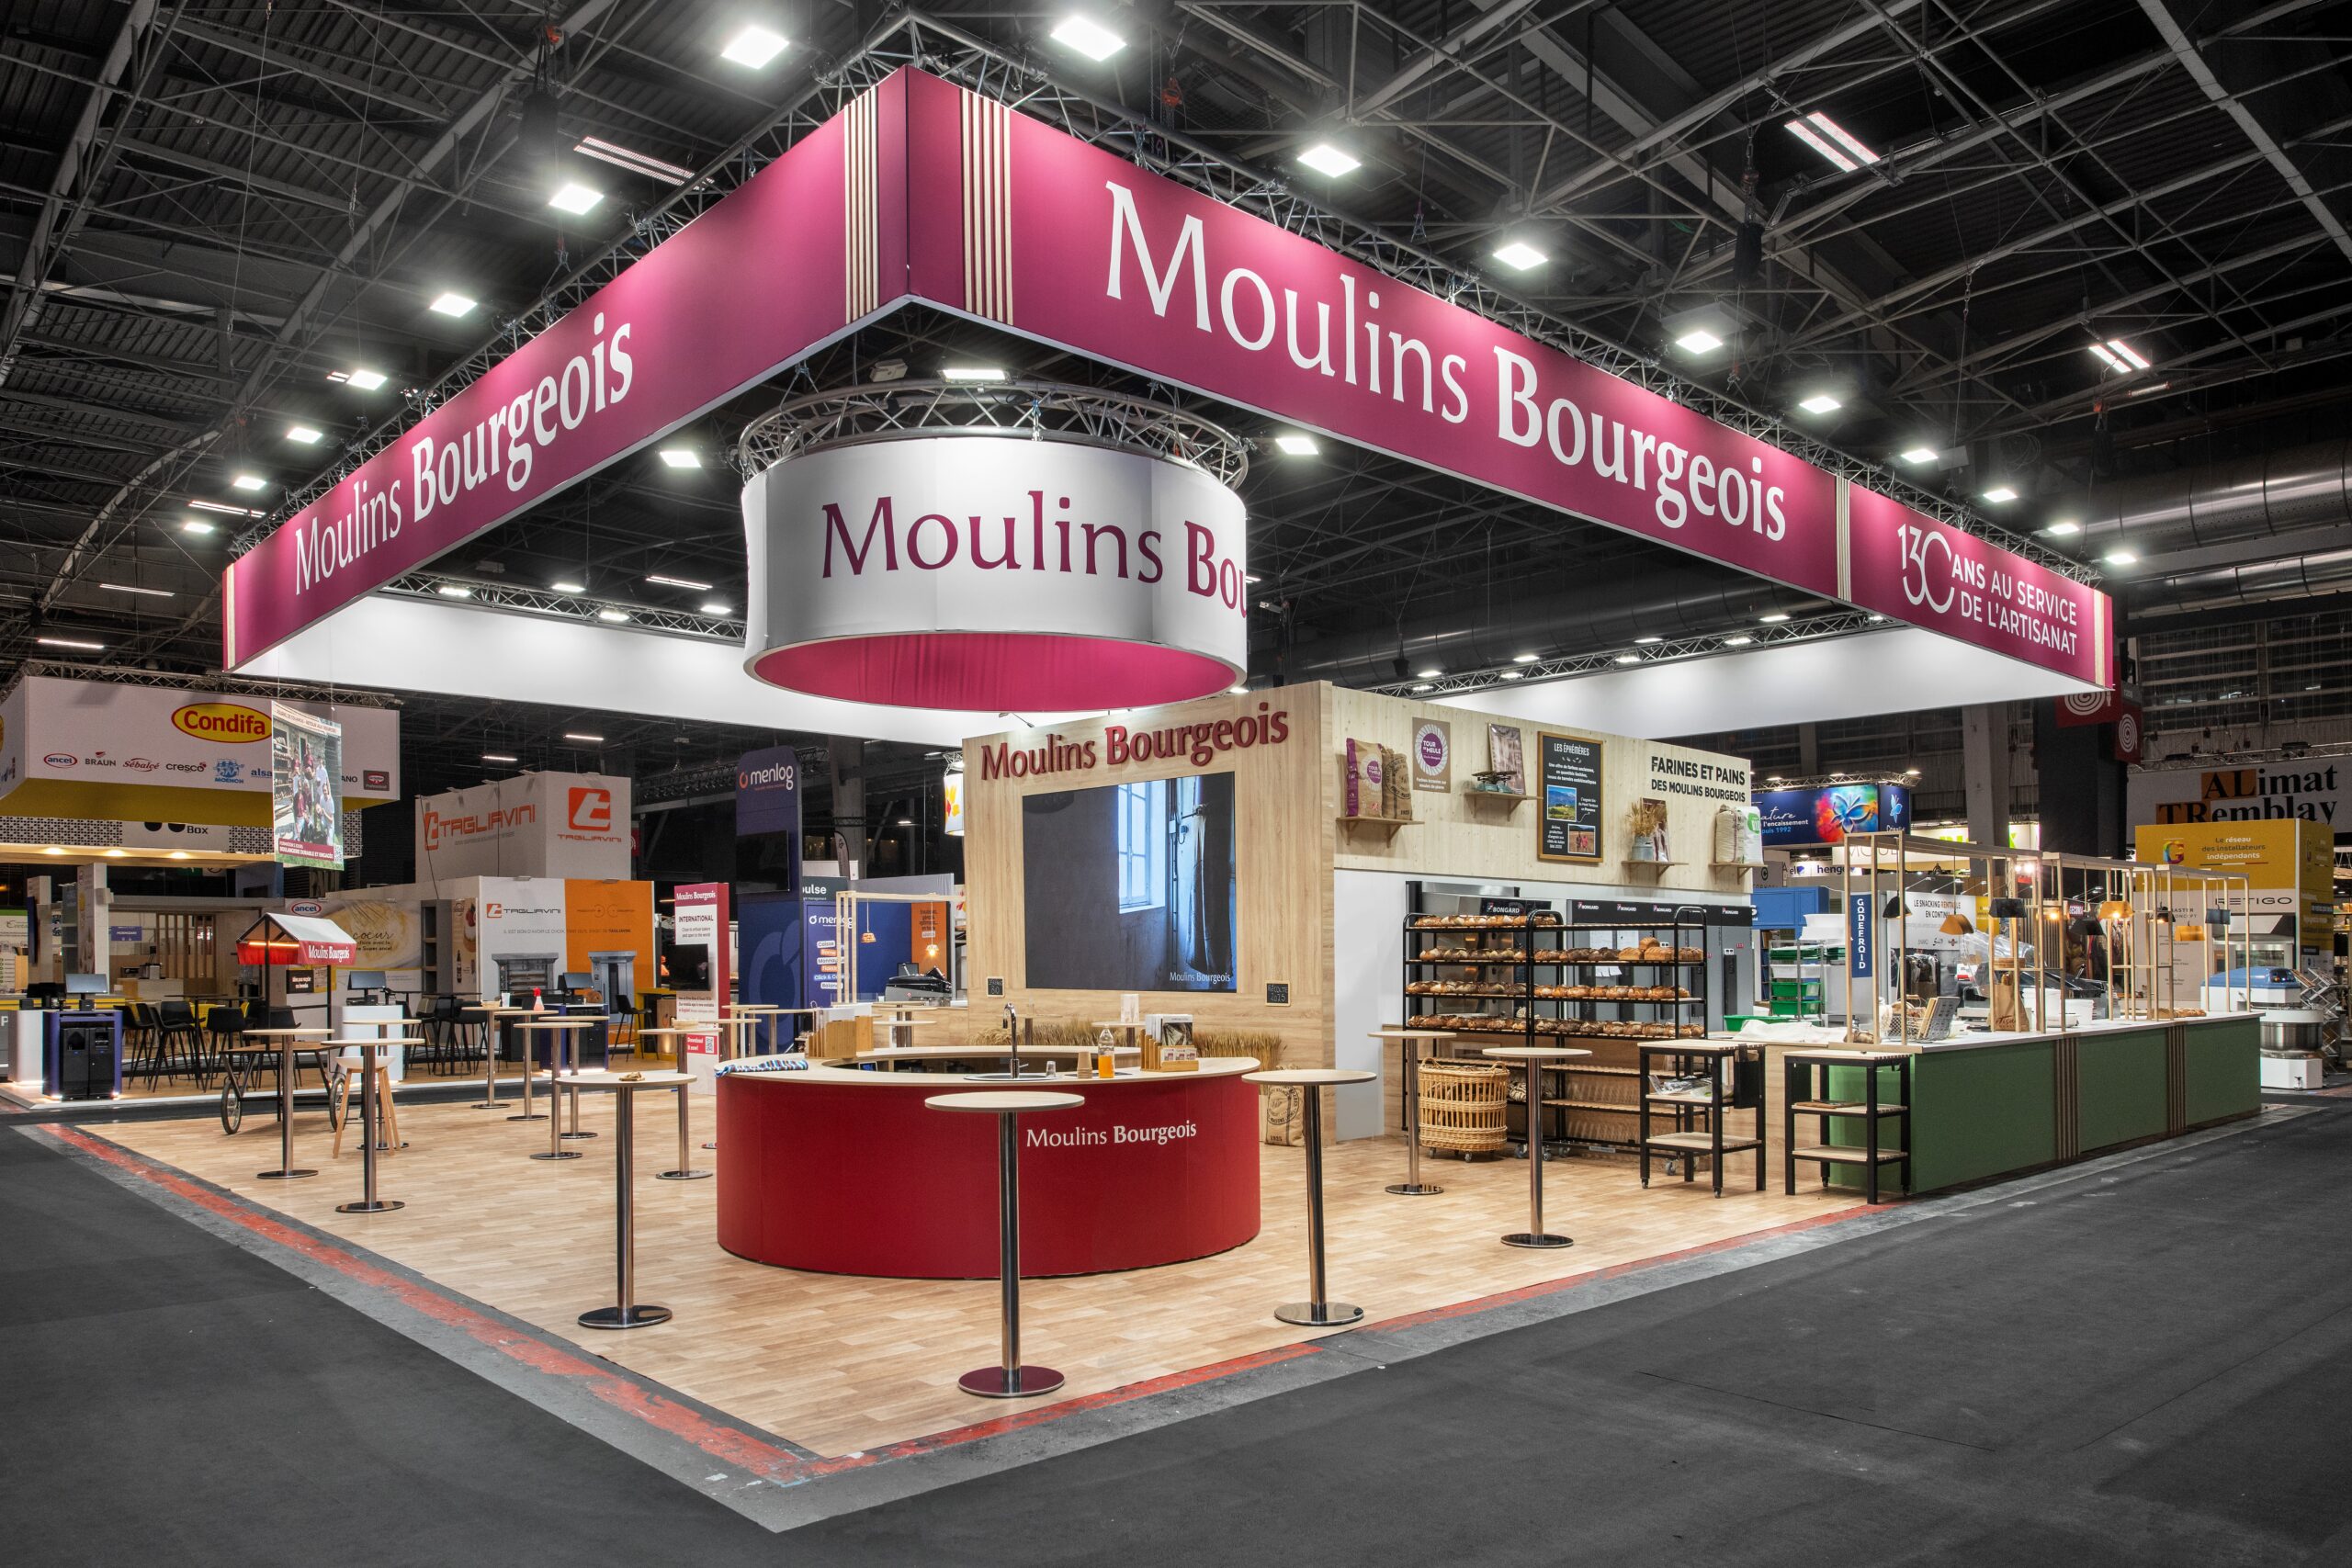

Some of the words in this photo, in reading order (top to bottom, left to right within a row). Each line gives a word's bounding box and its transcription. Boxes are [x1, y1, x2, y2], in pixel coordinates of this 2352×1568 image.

[1105, 180, 1468, 423] Moulins
[1493, 344, 1786, 541] Bourgeois
[295, 479, 401, 595] Moulins
[411, 311, 633, 523] Bourgeois
[822, 491, 1164, 583] Moulins
[1897, 523, 1955, 614] 130
[1951, 553, 1985, 590] ANS
[1990, 570, 2012, 600] AU
[2017, 580, 2077, 626] SERVICE
[1961, 591, 1983, 623] DE
[1987, 601, 2077, 656] L'ARTISANAT
[184, 710, 266, 735] Condifa
[980, 734, 1096, 781] Moulins
[1104, 702, 1289, 767] Bourgeois
[1554, 743, 1562, 752] LES
[85, 758, 117, 767] BRAUN
[165, 763, 205, 773] cresco
[251, 768, 273, 777] alsa
[1651, 755, 1698, 778] FARINES
[1701, 763, 1713, 780] ET
[1716, 767, 1746, 786] PAINS
[750, 762, 794, 790] menlog
[2204, 765, 2338, 799] ALimat
[1651, 779, 1668, 792] DES
[1669, 782, 1703, 797] MOULINS
[1705, 786, 1746, 803] BOURGEOIS
[187, 825, 209, 835] Box
[439, 804, 536, 837] TAGLIAVINI
[677, 892, 693, 900] Moulins
[693, 890, 716, 901] Bourgeois
[1919, 900, 1940, 908] SNACKING
[1941, 901, 1961, 909] RENTALE
[308, 944, 328, 959] Moulins
[328, 946, 350, 962] Bourgeois
[1169, 972, 1195, 982] Moulins
[1196, 972, 1231, 984] Bourgeois
[1026, 1127, 1108, 1147] Moulins
[1113, 1120, 1197, 1146] Bourgeois
